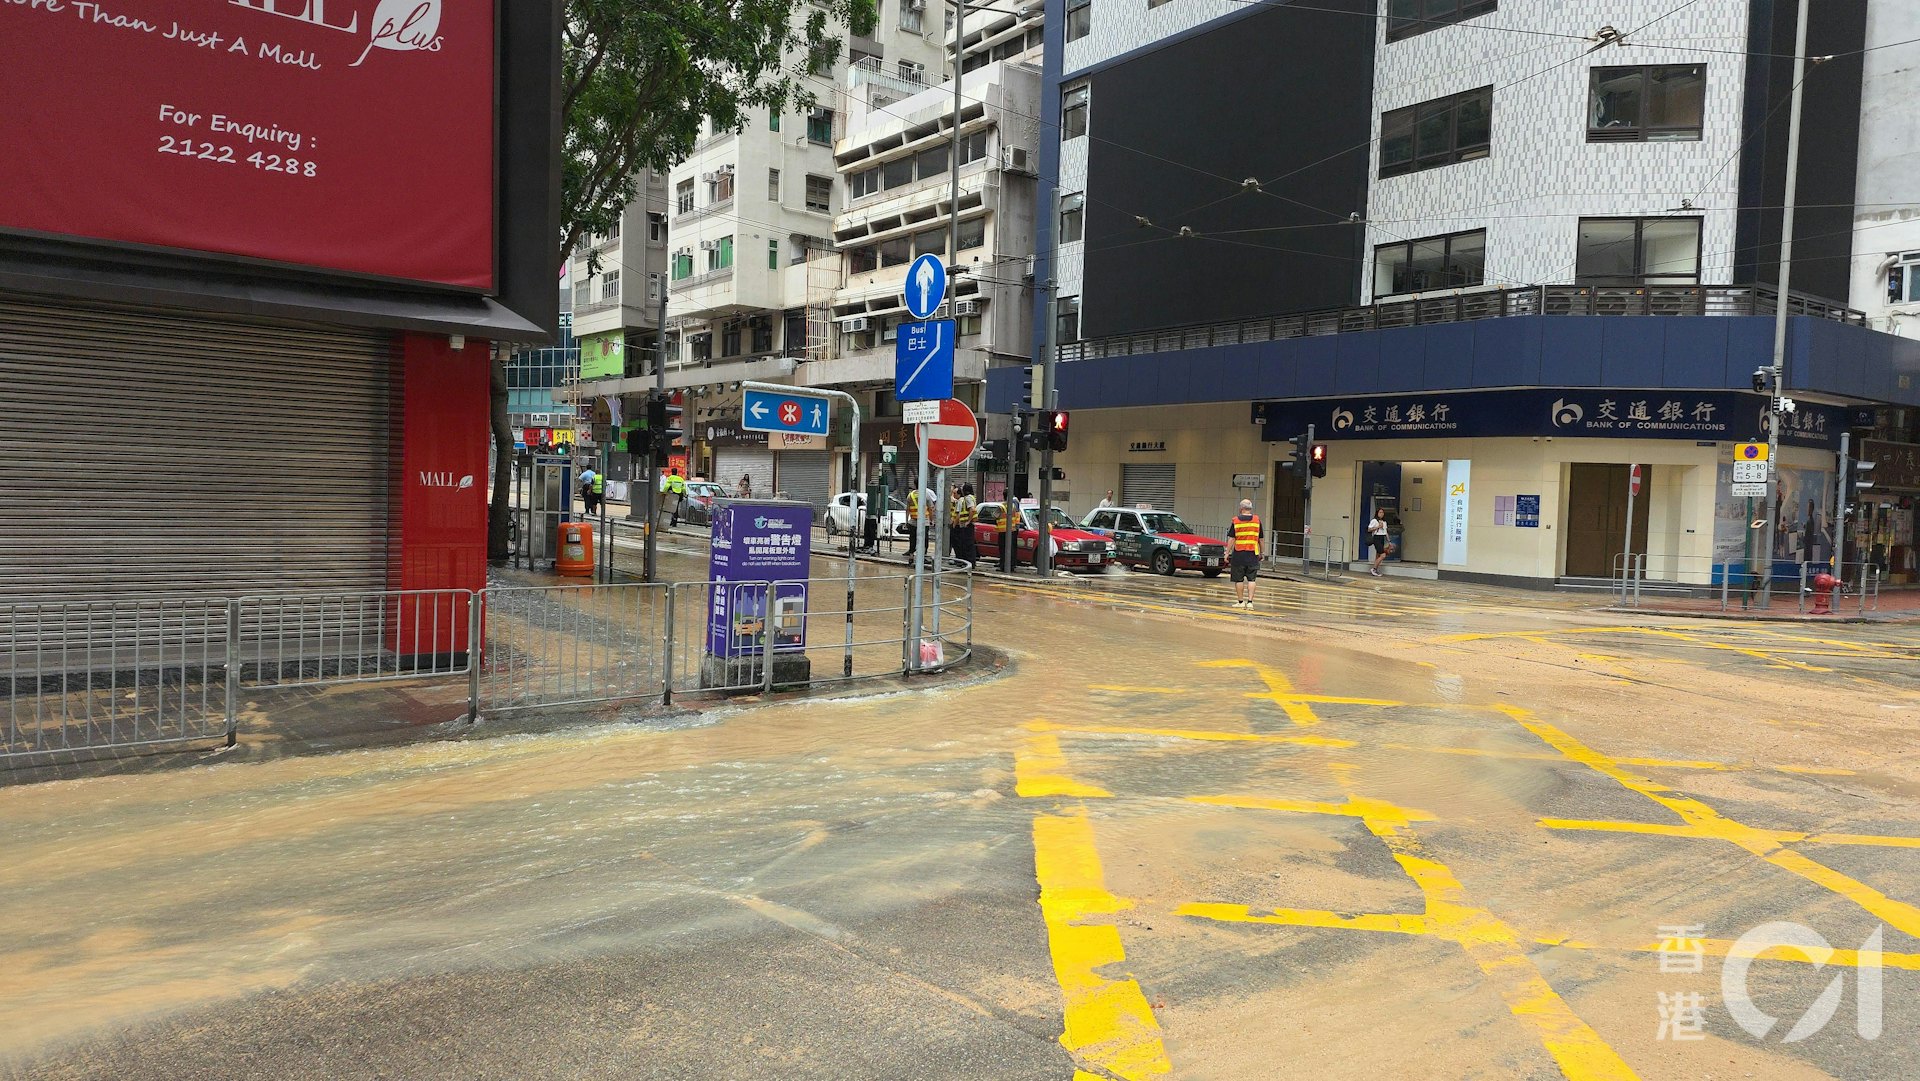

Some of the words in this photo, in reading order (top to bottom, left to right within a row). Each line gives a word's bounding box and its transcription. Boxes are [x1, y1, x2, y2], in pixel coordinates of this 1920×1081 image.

[71, 1, 156, 32] Than
[162, 22, 223, 49] Just
[228, 37, 248, 55] A
[258, 42, 321, 70] Mall
[372, 2, 444, 51] plus
[159, 104, 201, 126] For
[211, 114, 300, 151] Enquiry
[158, 136, 236, 163] 2122
[247, 151, 317, 177] 4288
[911, 326, 924, 334] Bus
[908, 337, 926, 351] 巴士
[1362, 403, 1450, 423] 交通銀行
[1597, 399, 1717, 422] 交通銀行
[1391, 423, 1457, 431] COMMUNICATIONS
[1586, 421, 1613, 429] BANK
[1637, 422, 1726, 431] COMMUNICATIONS
[419, 471, 458, 487] MALL
[1451, 482, 1465, 496] 24
